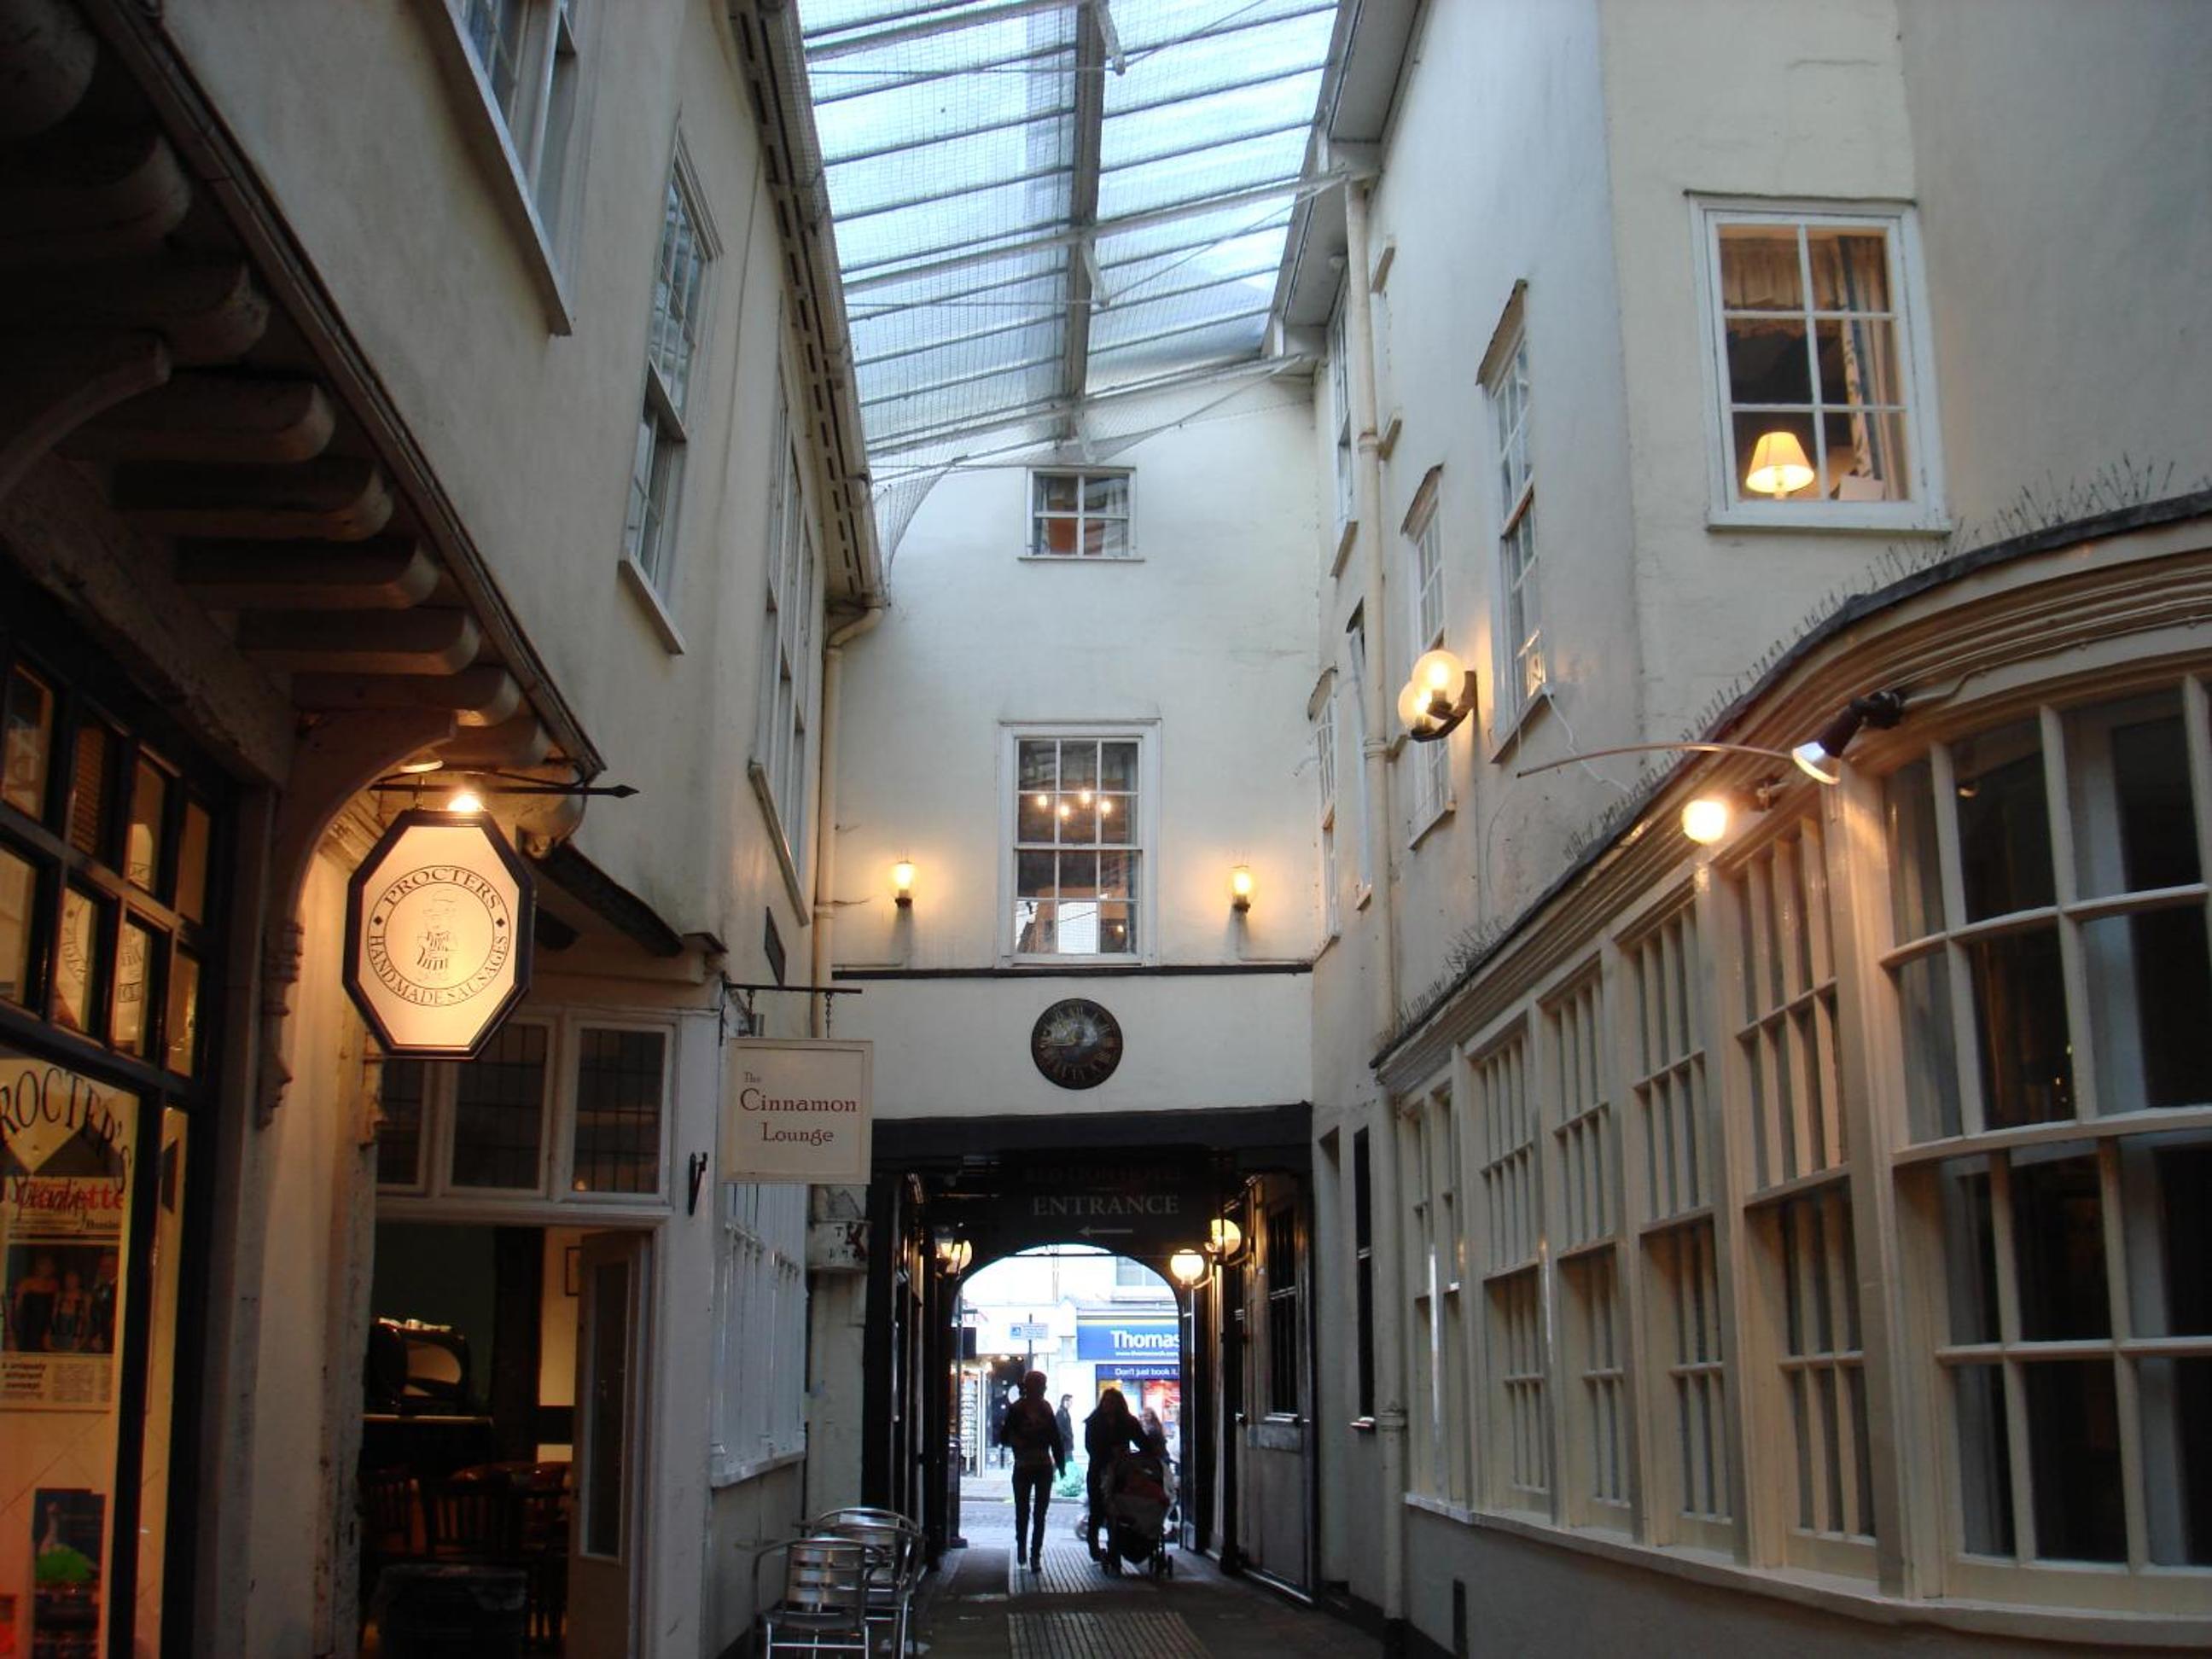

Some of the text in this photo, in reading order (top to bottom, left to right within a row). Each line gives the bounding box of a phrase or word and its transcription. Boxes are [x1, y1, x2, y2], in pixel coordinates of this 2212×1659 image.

[384, 867, 503, 910] PROCTERS
[446, 935, 509, 999] SAUSAGES
[740, 1087, 858, 1113] Cinnamon
[761, 1121, 835, 1147] Lounge
[1033, 1196, 1180, 1216] ENTRANCE
[1110, 1330, 1180, 1349] Thomas
